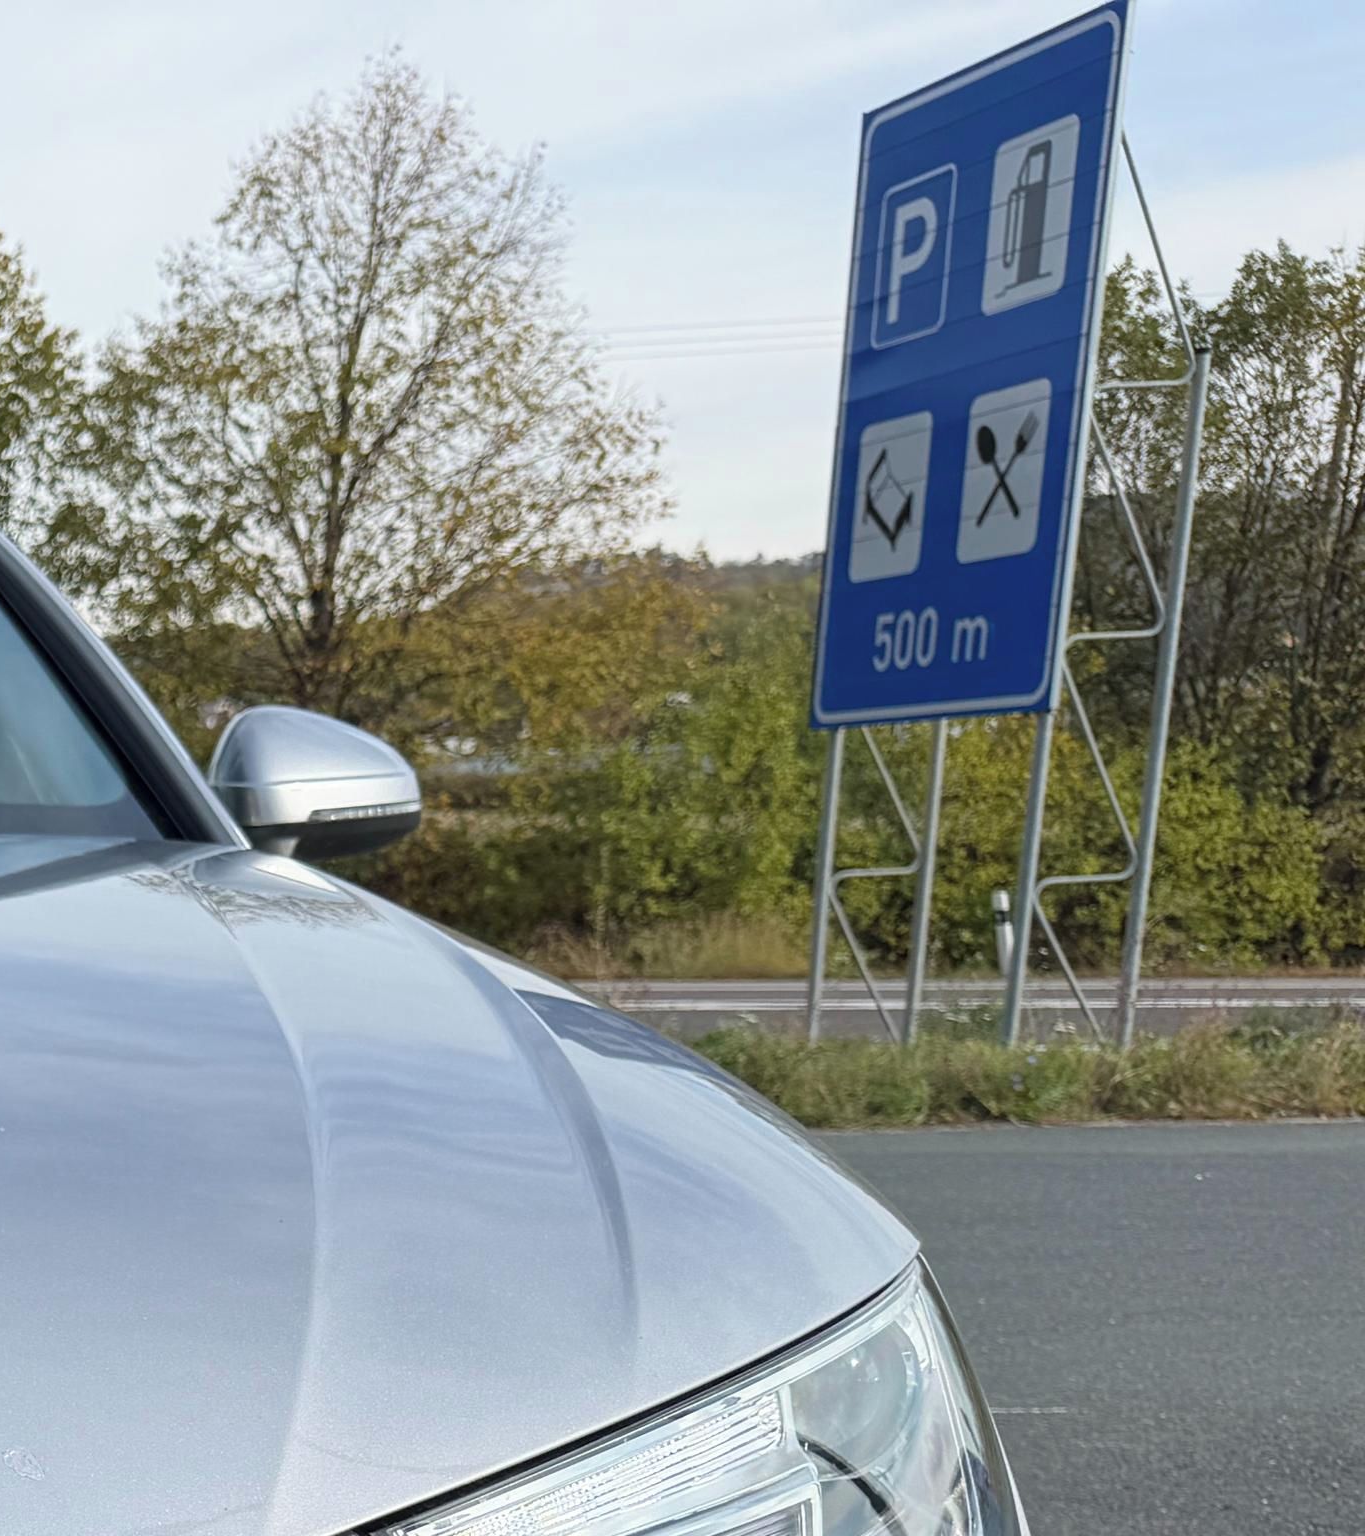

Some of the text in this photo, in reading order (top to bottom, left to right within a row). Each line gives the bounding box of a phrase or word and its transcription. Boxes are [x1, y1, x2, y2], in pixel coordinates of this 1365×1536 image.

[885, 196, 938, 325] P
[871, 606, 989, 673] 500 m
